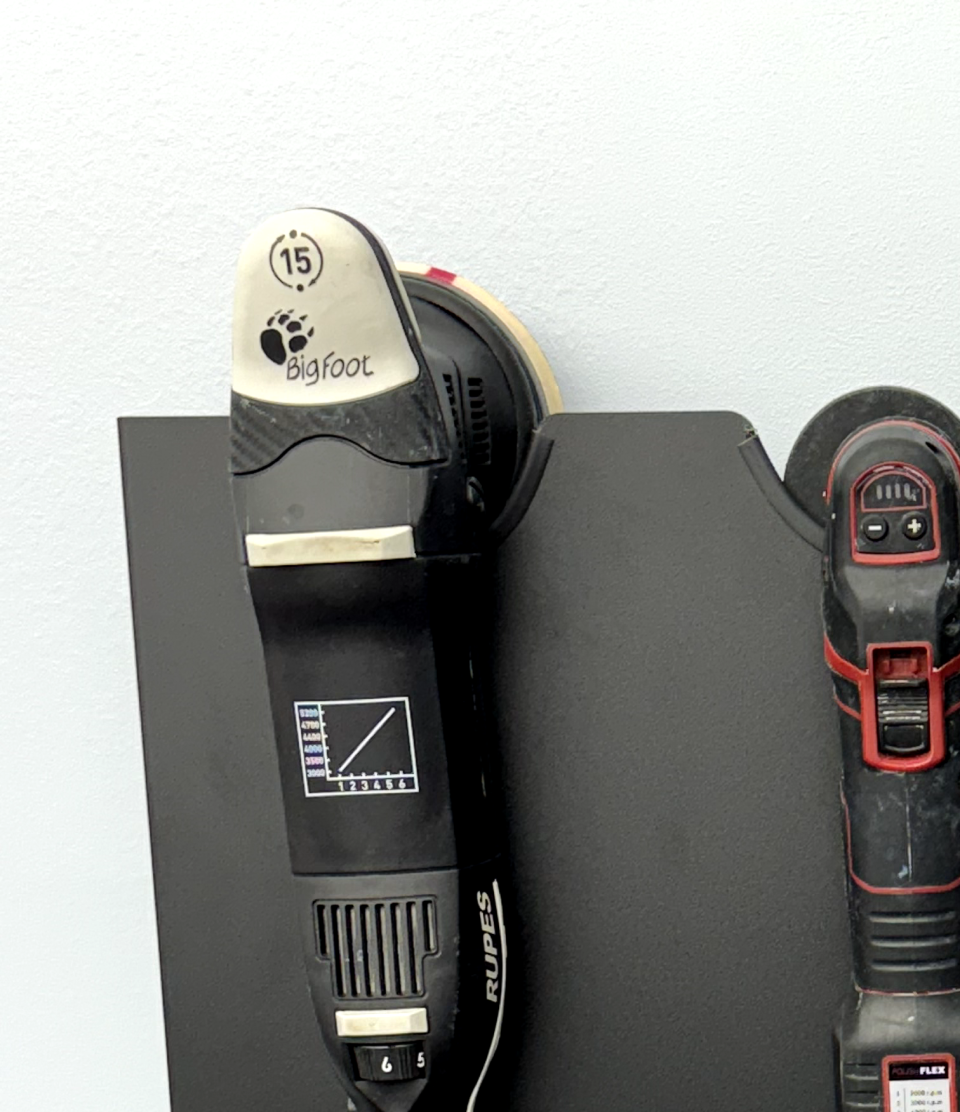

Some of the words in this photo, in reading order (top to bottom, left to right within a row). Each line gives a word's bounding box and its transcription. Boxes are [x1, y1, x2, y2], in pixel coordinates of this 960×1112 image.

[279, 246, 312, 275] 15
[349, 781, 357, 790] 2
[361, 781, 369, 790] 3
[373, 780, 381, 789] 4
[386, 779, 393, 789] 5
[398, 779, 406, 788] 6
[476, 890, 498, 1003] RUPES
[381, 1056, 393, 1073] 6
[416, 1052, 425, 1068] 5
